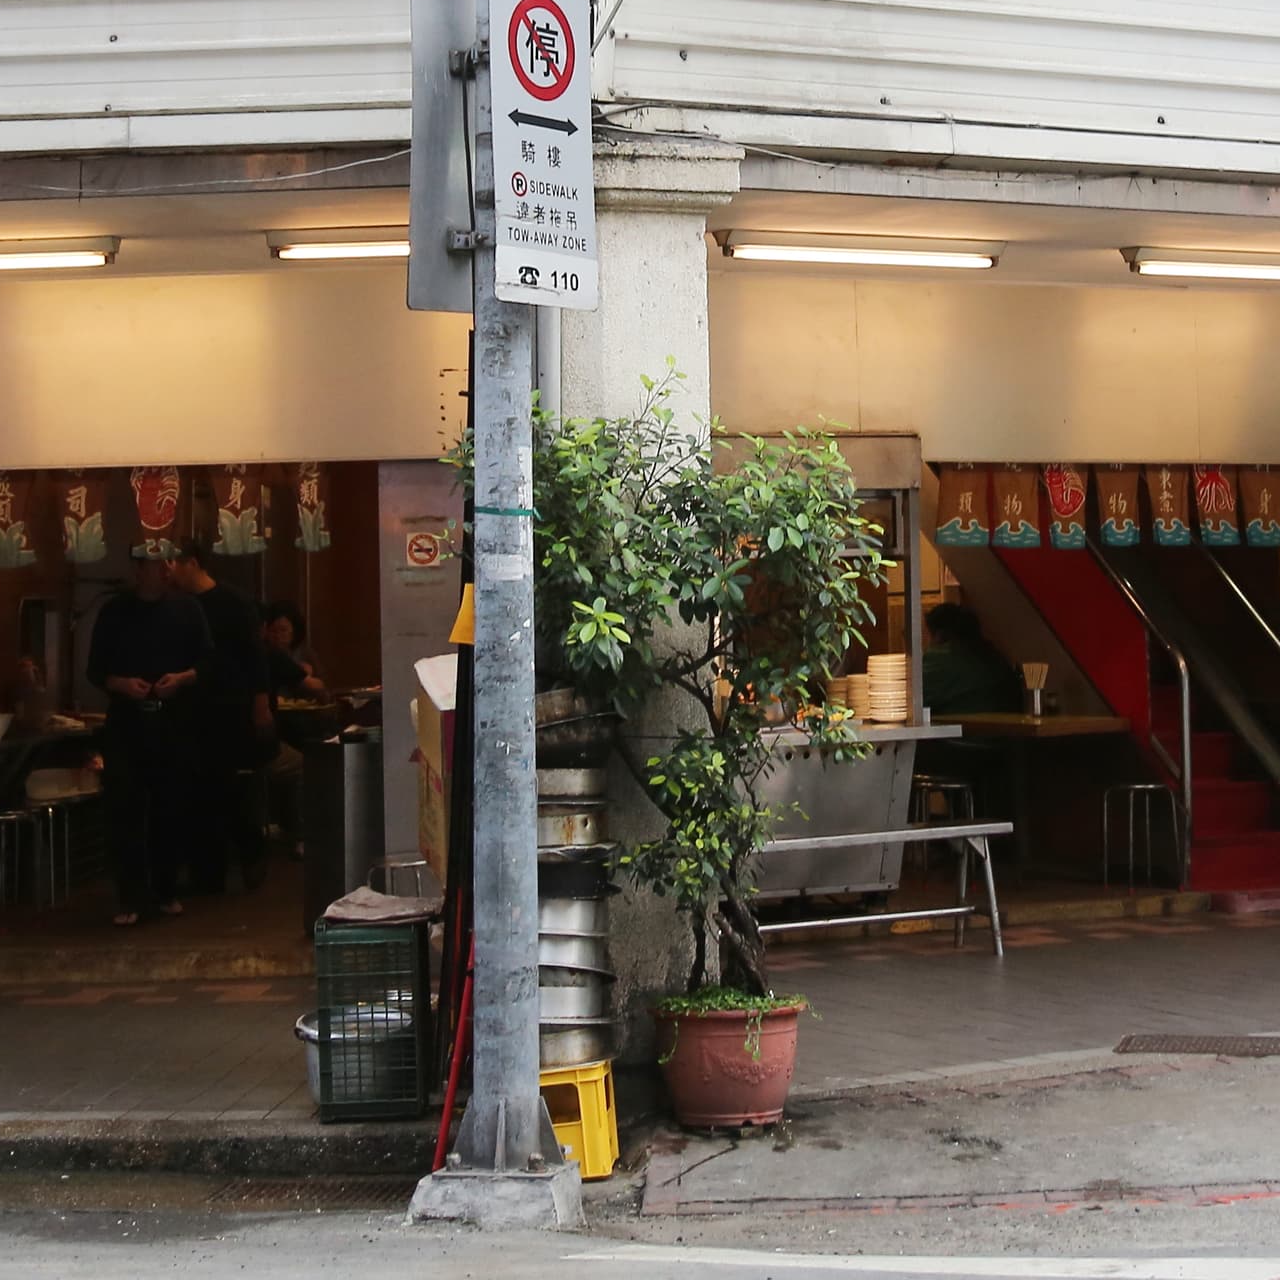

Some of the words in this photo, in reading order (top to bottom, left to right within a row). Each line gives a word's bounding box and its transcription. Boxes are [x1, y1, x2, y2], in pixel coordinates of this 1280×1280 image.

[525, 18, 561, 78] 停
[520, 139, 563, 169] 騎樓
[529, 179, 579, 202] SIDEWALK
[516, 201, 578, 231] 違者拖吊
[562, 230, 587, 253] ZONE
[549, 271, 580, 292] 110
